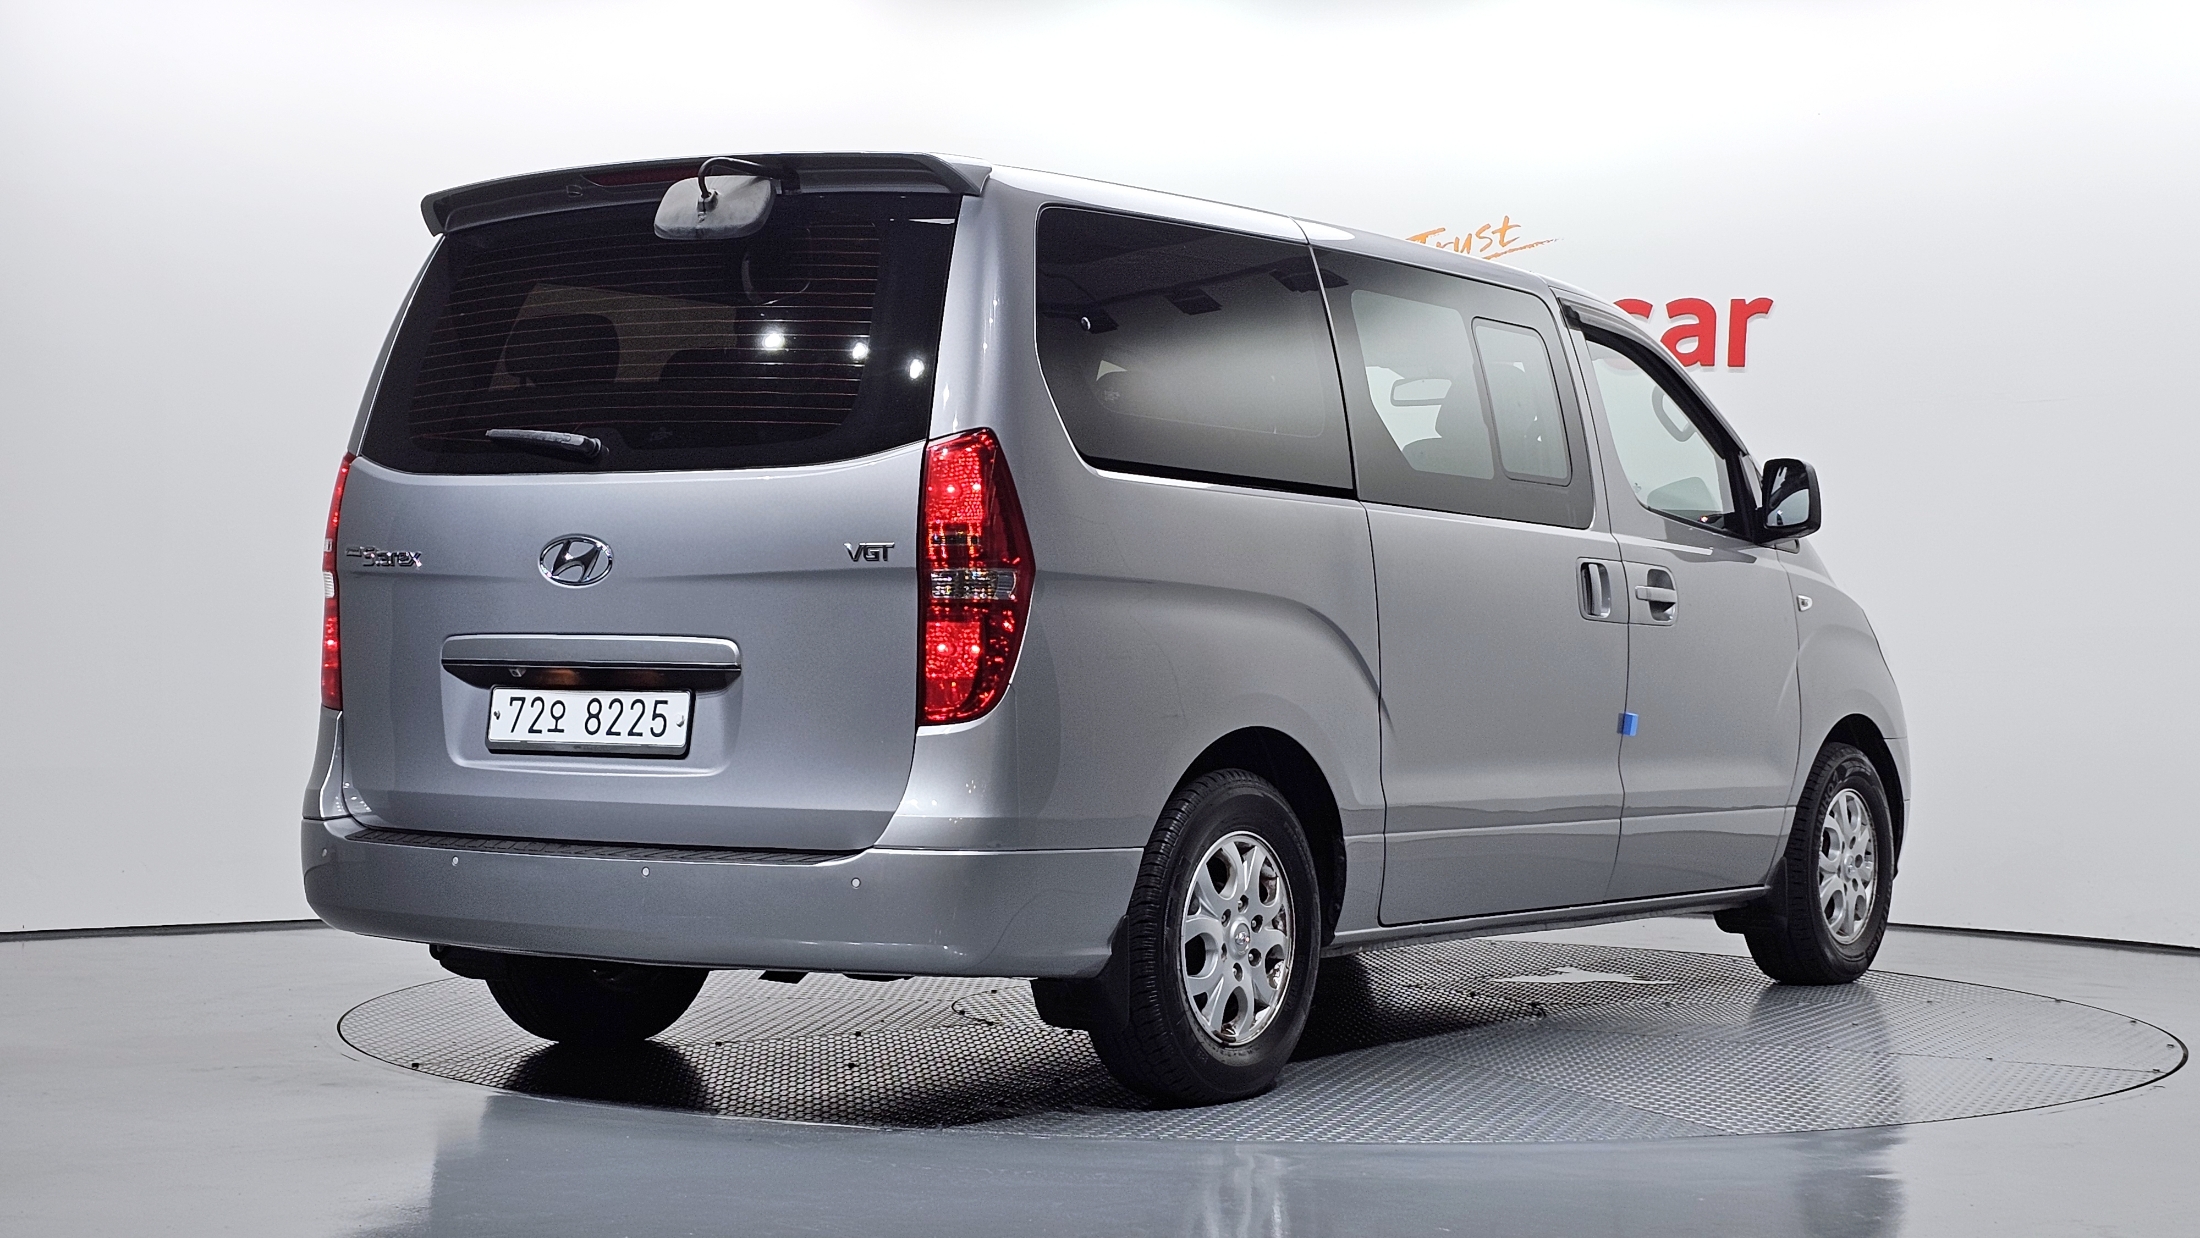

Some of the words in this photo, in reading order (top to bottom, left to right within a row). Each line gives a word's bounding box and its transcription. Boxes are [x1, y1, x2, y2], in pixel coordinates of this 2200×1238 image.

[843, 542, 895, 562] VGT
[509, 696, 566, 734] 72오
[584, 697, 669, 738] 8225
